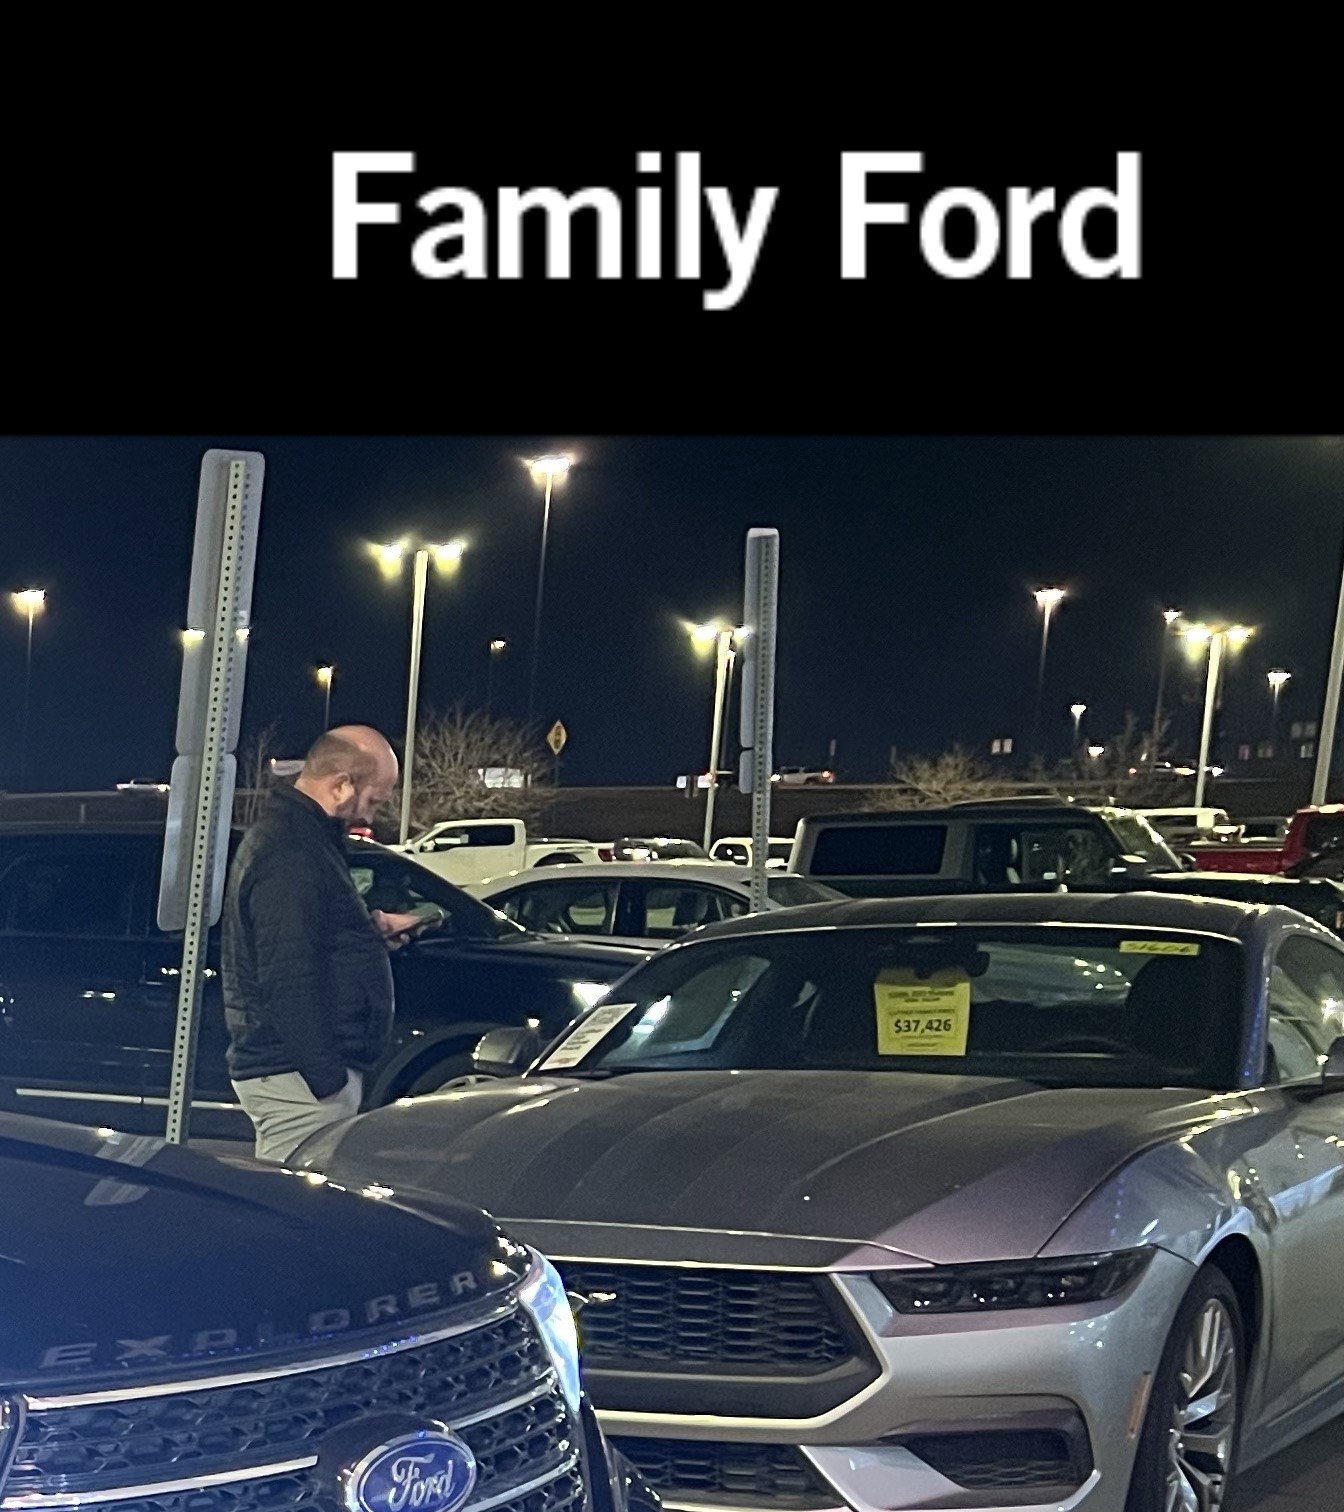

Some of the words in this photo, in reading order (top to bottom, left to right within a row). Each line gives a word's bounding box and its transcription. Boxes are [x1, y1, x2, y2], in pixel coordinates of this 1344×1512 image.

[893, 1018, 953, 1035] $37,426
[38, 1269, 479, 1369] EXPLORER
[388, 1452, 457, 1512] Ford
